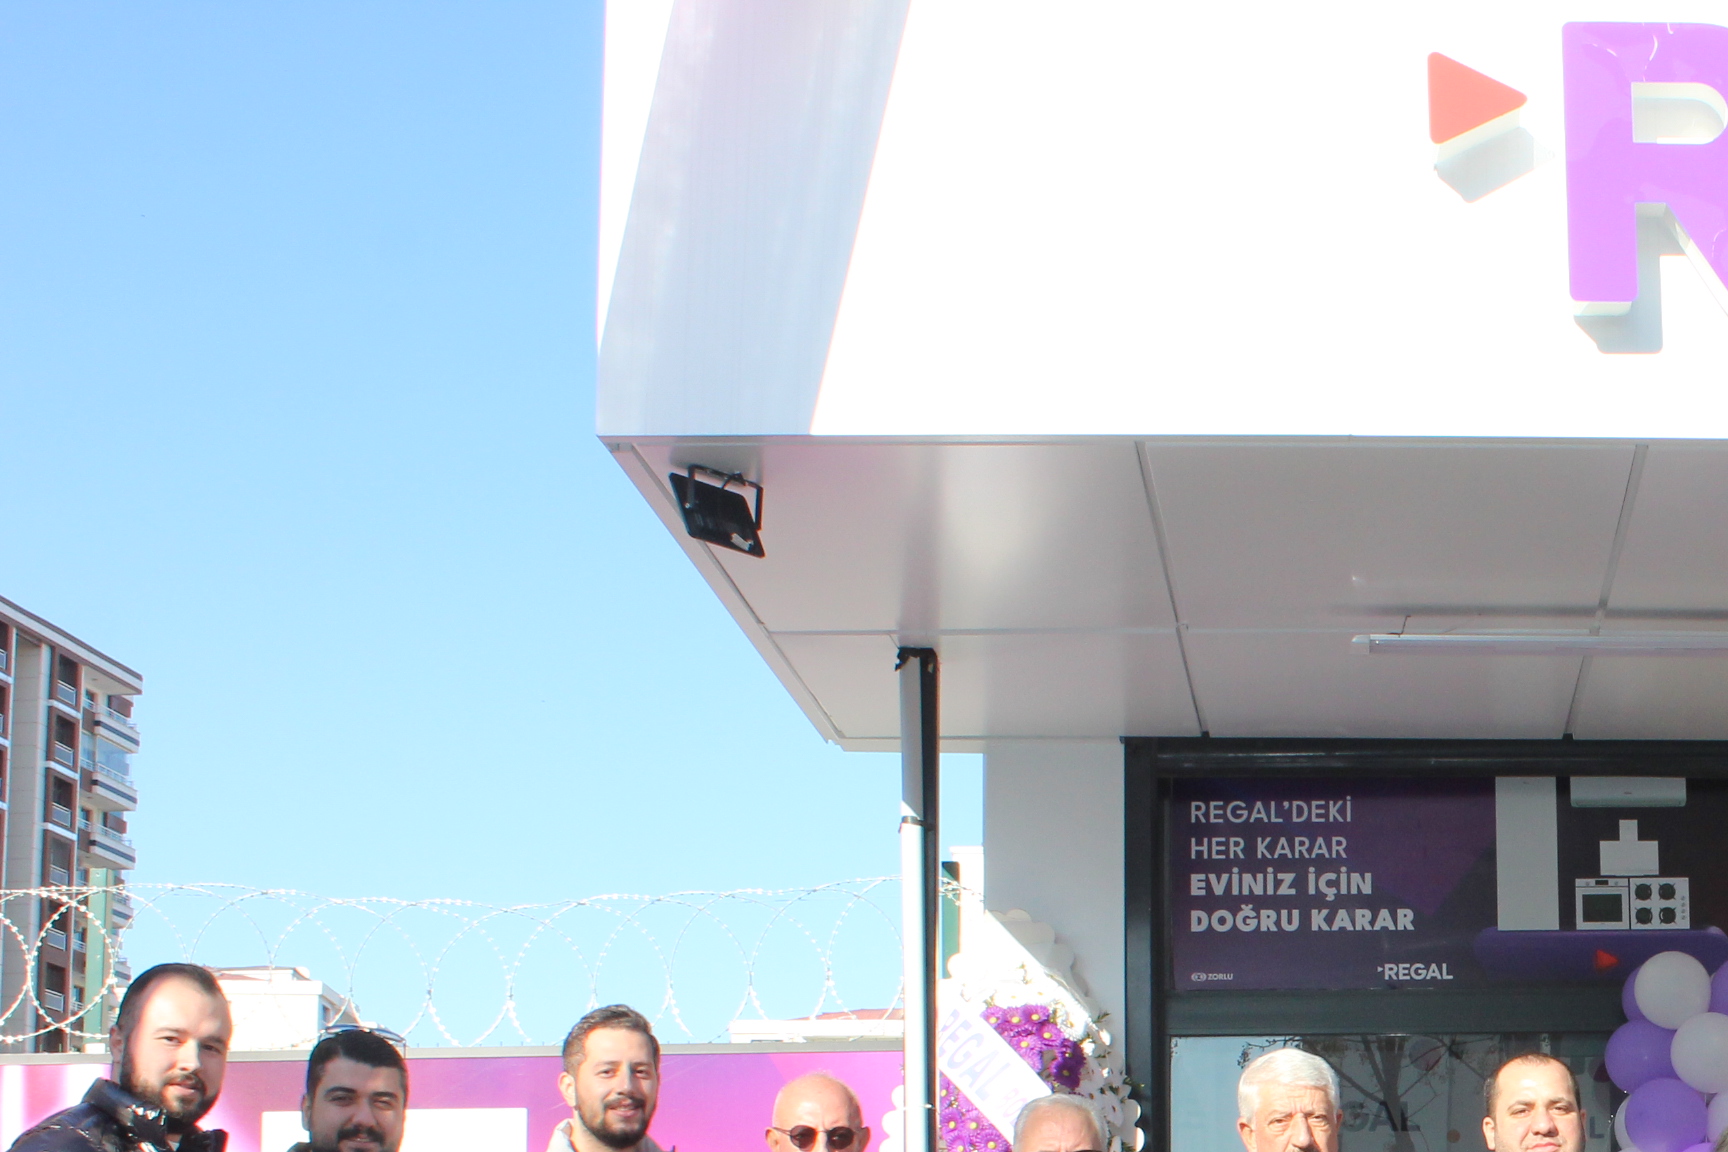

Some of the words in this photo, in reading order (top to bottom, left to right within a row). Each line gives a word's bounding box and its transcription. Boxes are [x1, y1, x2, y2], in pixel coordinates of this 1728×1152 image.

[1190, 837, 1245, 860] HER
[1257, 837, 1348, 859] KARAR
[1190, 866, 1297, 896] EVİNİZ
[1307, 865, 1372, 902] İÇİN
[1190, 904, 1300, 933] DOĞRU
[1310, 908, 1415, 932] KARAR
[1207, 973, 1234, 981] ZORLU
[1384, 963, 1454, 981] REGAL
[1340, 1100, 1421, 1132] GAL
